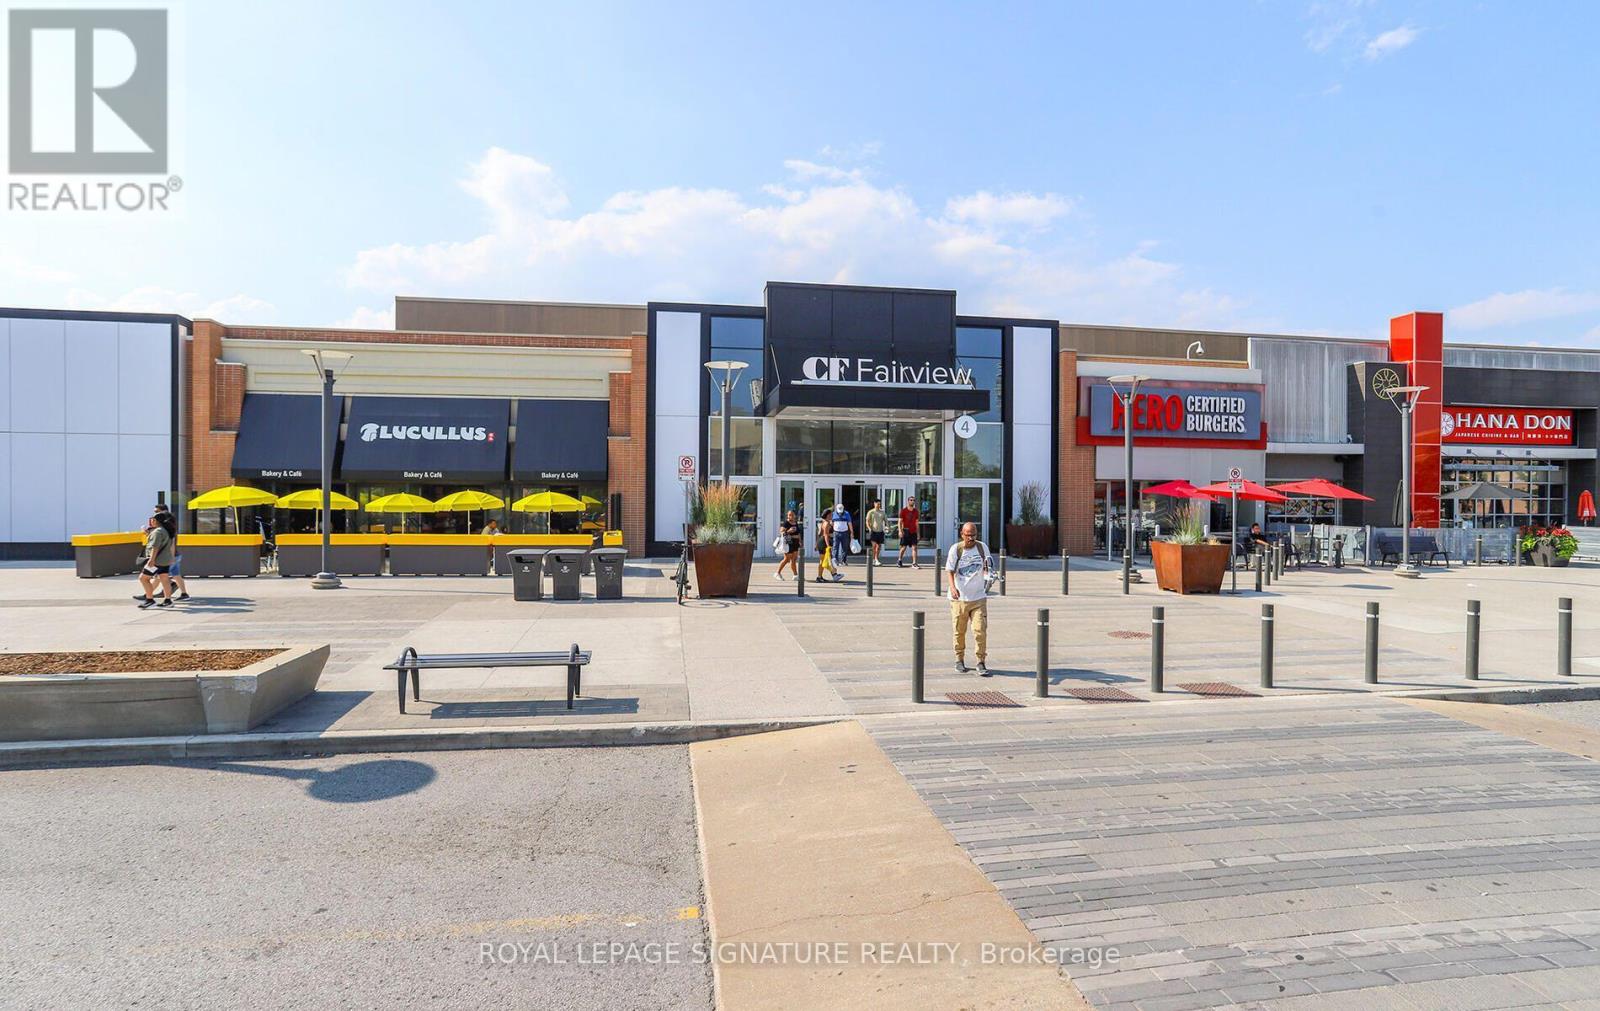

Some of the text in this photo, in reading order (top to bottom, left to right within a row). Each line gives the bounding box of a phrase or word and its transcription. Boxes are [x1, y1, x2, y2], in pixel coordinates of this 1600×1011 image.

[802, 356, 972, 385] CF Fairview
[1112, 393, 1185, 431] HERO
[1186, 395, 1246, 414] CERTIFIED
[961, 421, 969, 433] 4
[1186, 414, 1246, 433] BURGERS
[1455, 412, 1572, 431] HANA DON
[380, 425, 487, 441] LUCULLUS
[261, 470, 282, 478] Bakery
[403, 471, 424, 479] Bakery
[541, 471, 560, 480] Bakery
